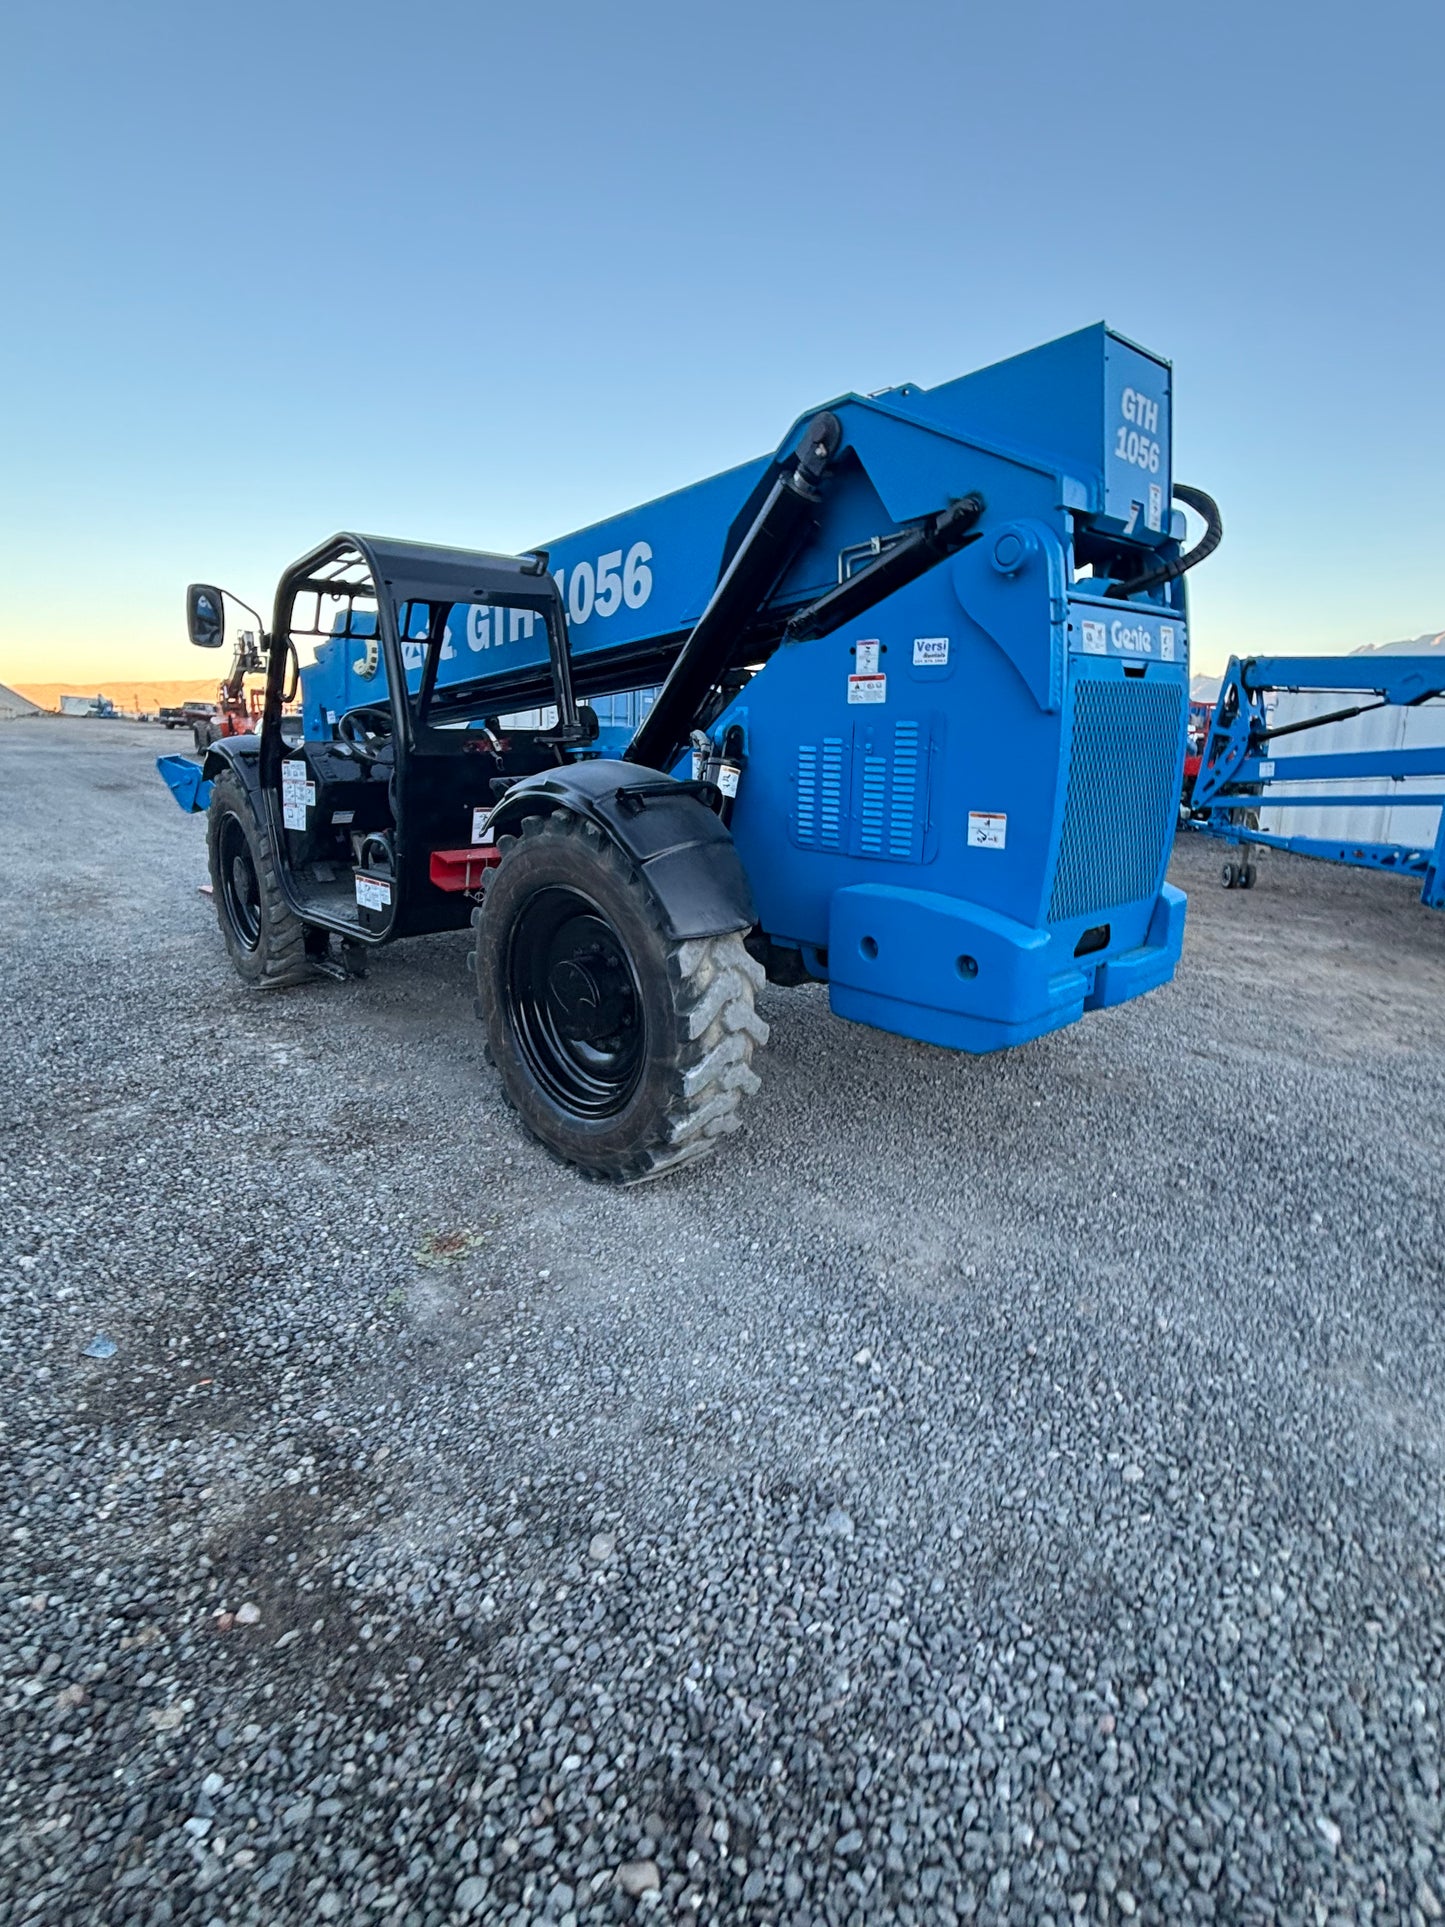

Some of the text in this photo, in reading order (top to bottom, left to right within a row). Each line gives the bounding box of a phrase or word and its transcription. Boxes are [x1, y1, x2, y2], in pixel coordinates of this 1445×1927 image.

[1121, 387, 1159, 435] GTH
[1114, 426, 1160, 474] 1056
[916, 639, 947, 652] Versi
[1111, 620, 1152, 653] Genie
